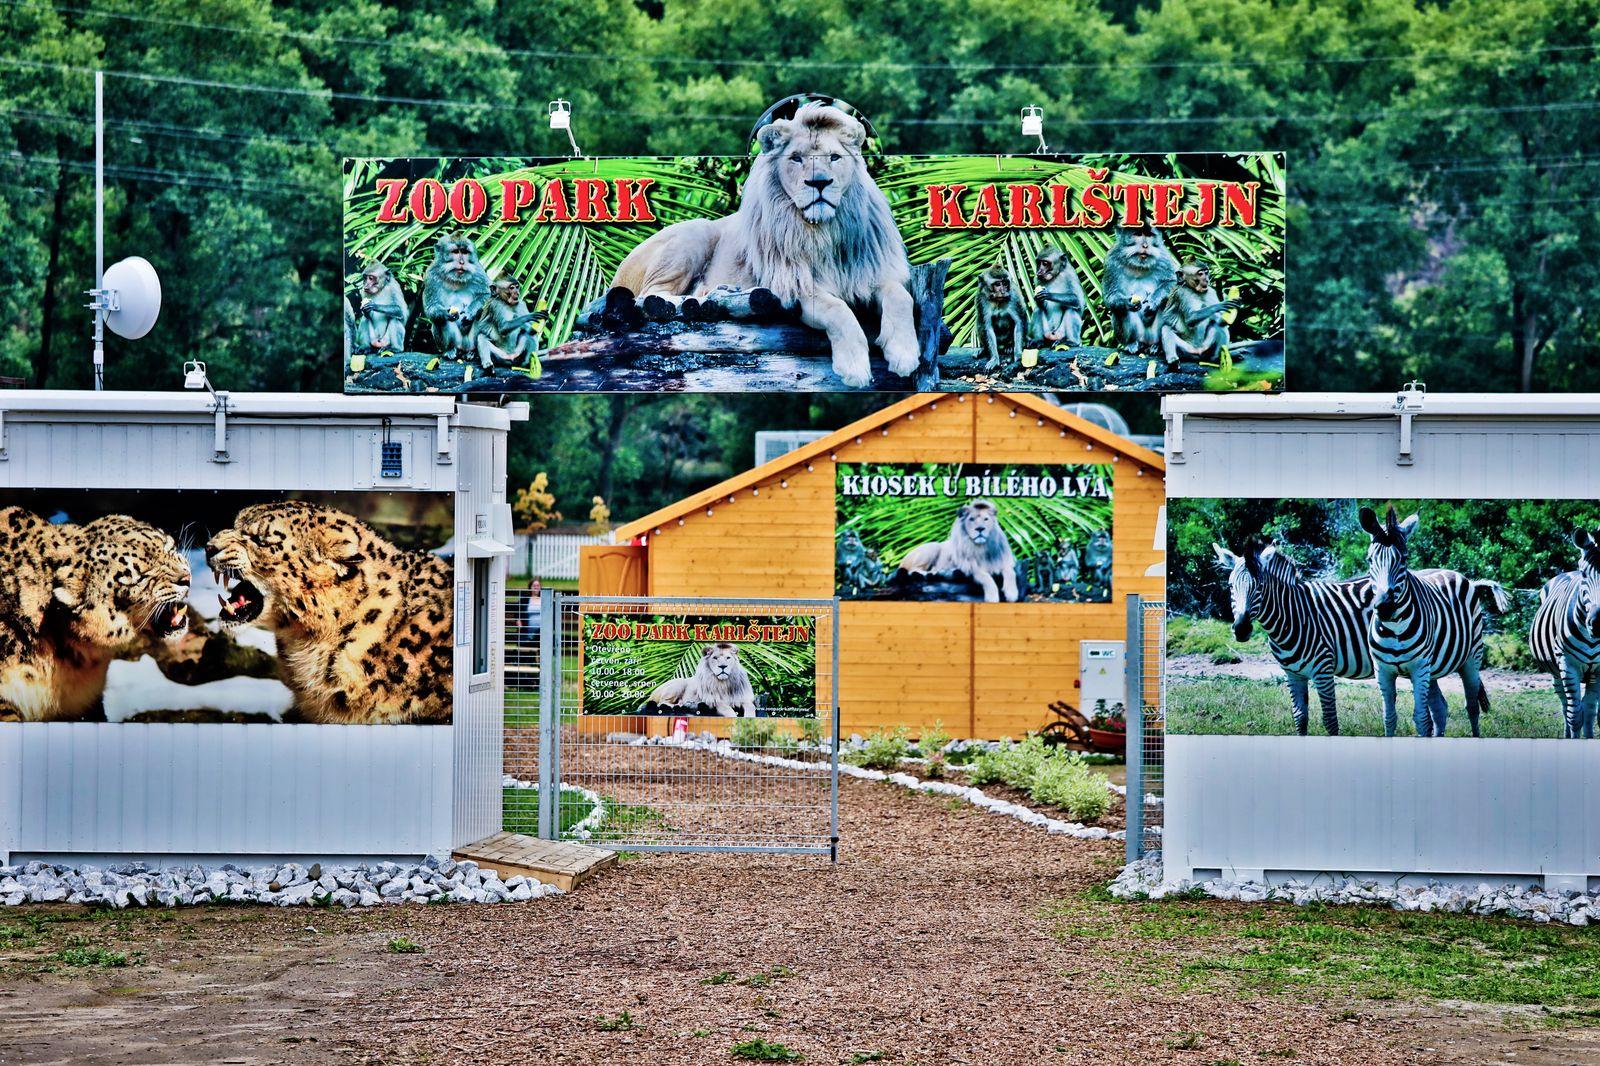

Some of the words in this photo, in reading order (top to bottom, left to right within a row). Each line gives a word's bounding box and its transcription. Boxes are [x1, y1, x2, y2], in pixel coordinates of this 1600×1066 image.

[375, 178, 487, 224] ZOO
[499, 178, 657, 224] PARK
[924, 167, 1261, 229] KARLŠTEJN
[842, 475, 936, 497] KIOSEK
[942, 475, 958, 497] U
[965, 469, 1057, 498] BÍLÉHO
[1063, 475, 1109, 498] LVA
[591, 622, 631, 640] ZOO
[636, 623, 690, 641] PARK
[694, 620, 810, 642] KARLŠTEJN
[591, 667, 615, 676] 10.00
[591, 690, 615, 698] 10.00
